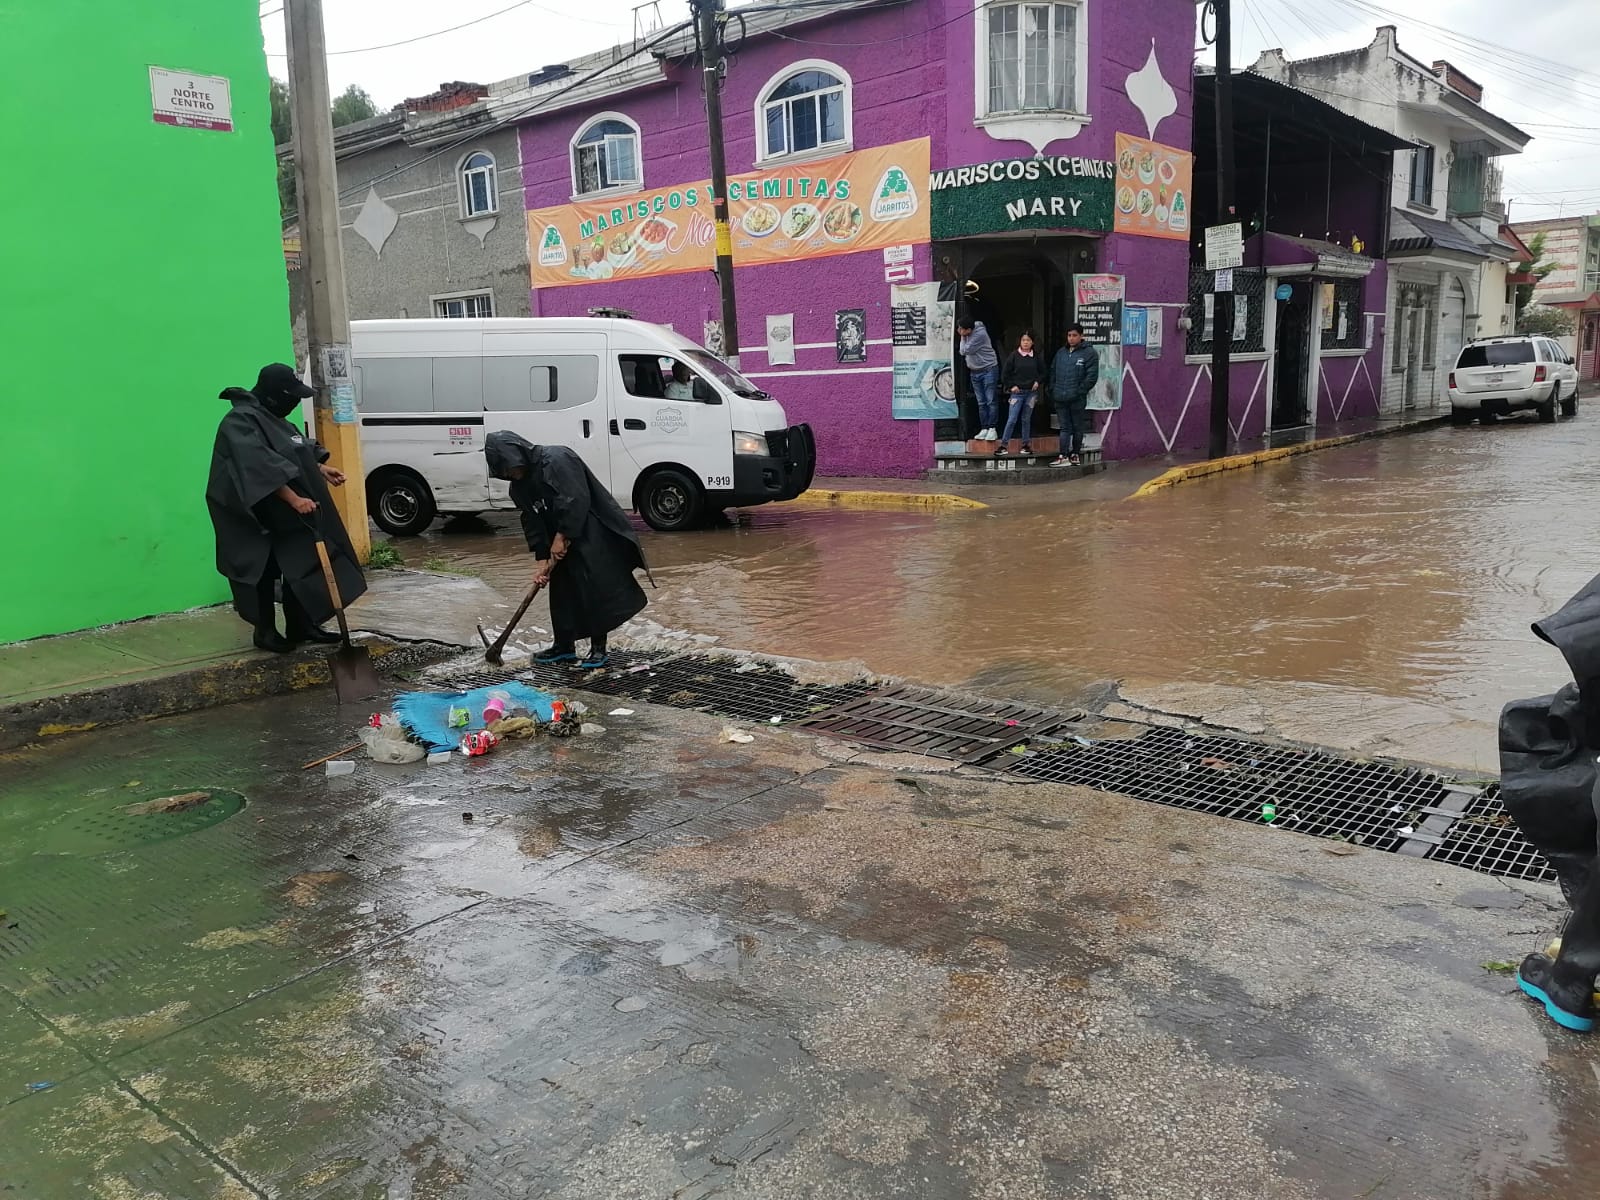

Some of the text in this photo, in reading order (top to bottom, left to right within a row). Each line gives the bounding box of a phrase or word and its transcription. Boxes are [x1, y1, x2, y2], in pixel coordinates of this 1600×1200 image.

[188, 81, 194, 90] 3
[173, 88, 211, 101] NORTE
[170, 97, 214, 111] CENTRO
[928, 156, 1113, 191] MARISCOS Y CEMITAS
[579, 187, 699, 241] MARISCOS
[728, 177, 850, 201] CEMITAS
[876, 200, 911, 214] JARRITOS
[1006, 196, 1082, 221] MARY
[449, 427, 471, 435] 911
[707, 476, 731, 486] P-919
